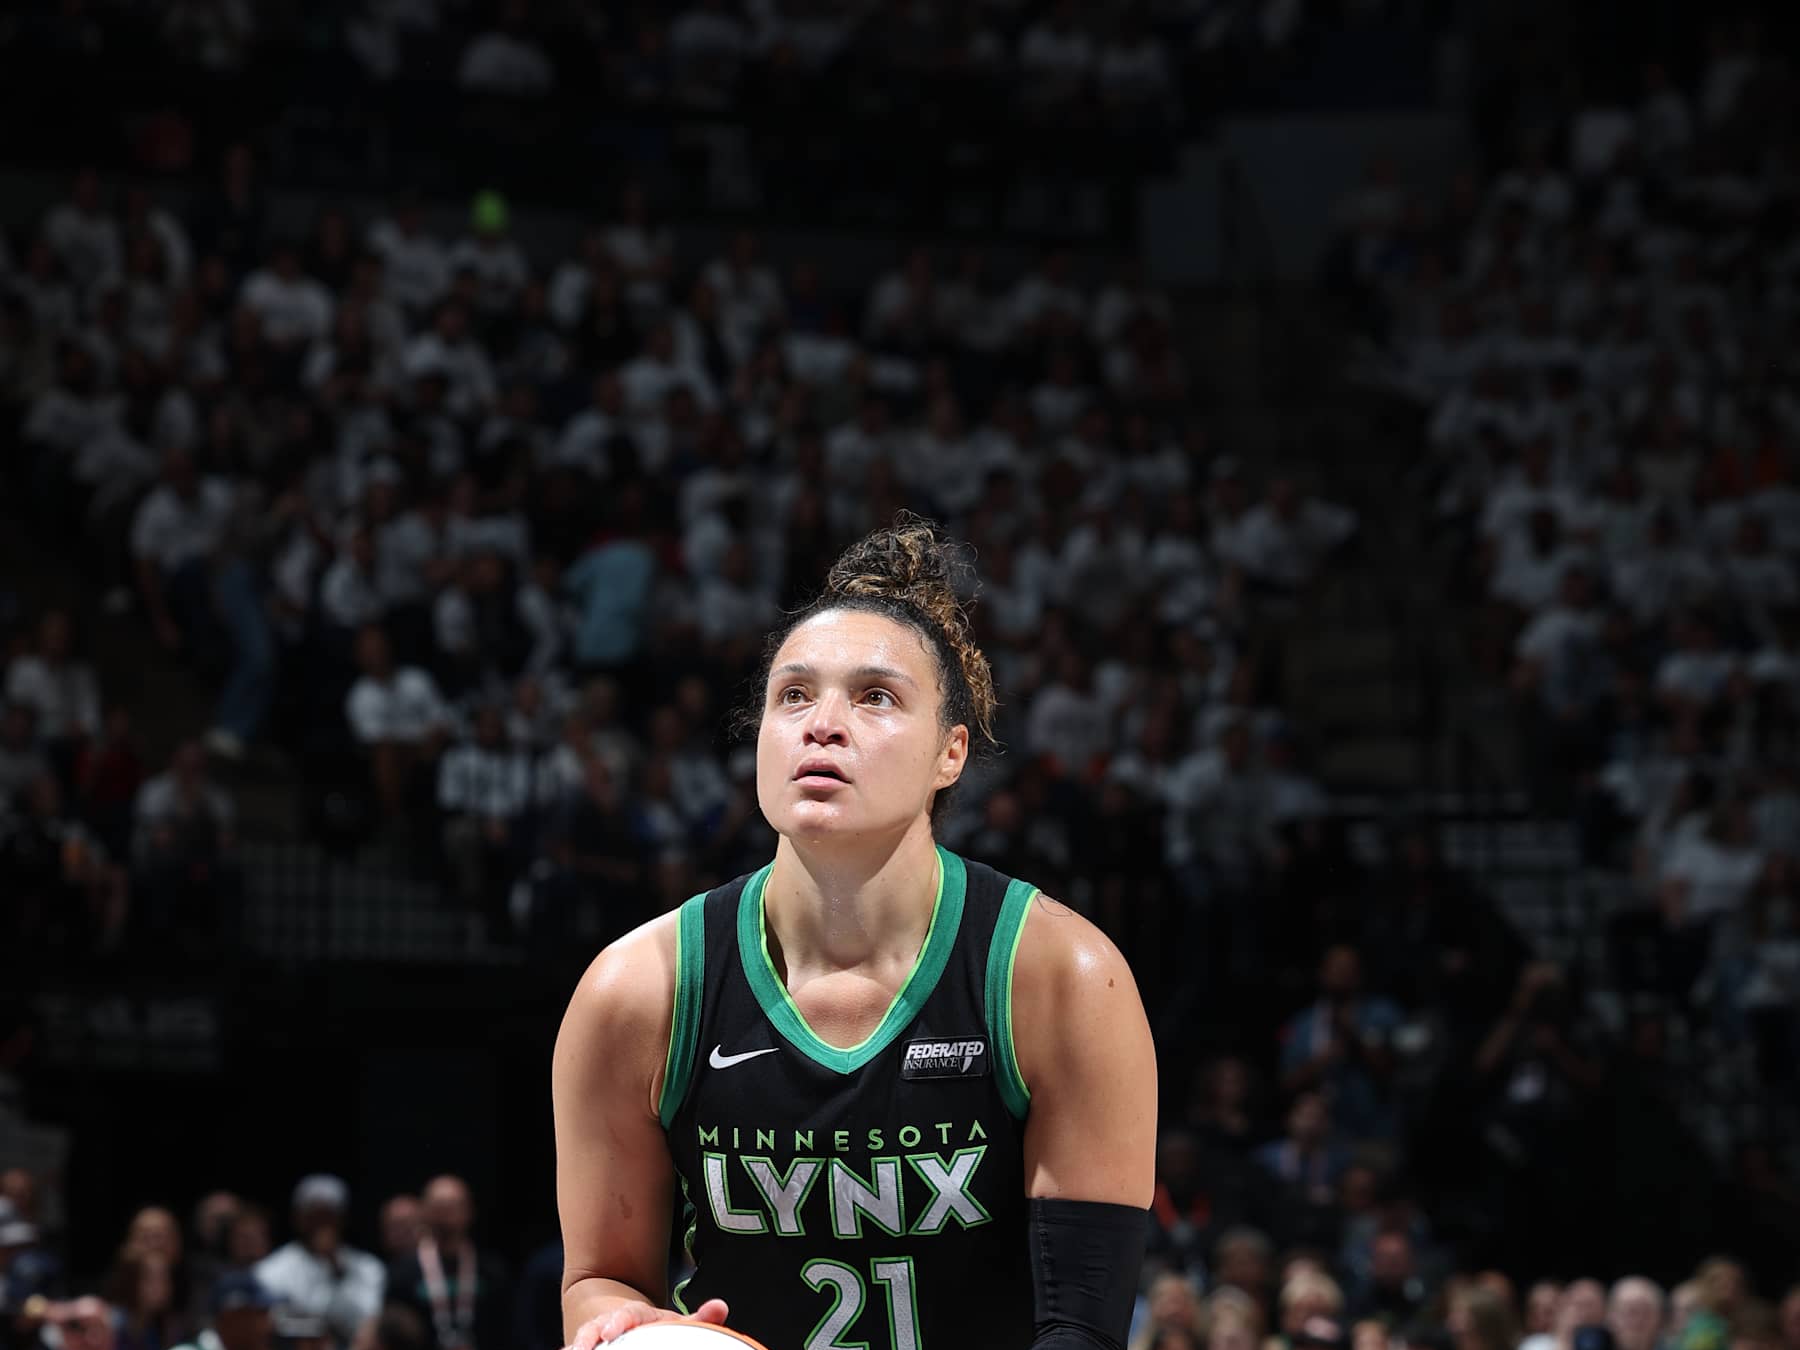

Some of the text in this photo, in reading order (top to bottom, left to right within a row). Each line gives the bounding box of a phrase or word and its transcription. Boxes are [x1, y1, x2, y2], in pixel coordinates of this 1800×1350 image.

[903, 1056, 958, 1071] INSURANCE
[905, 1041, 985, 1060] FEDERATED
[697, 1119, 989, 1152] MINNESOTA
[701, 1144, 994, 1240] LYNX
